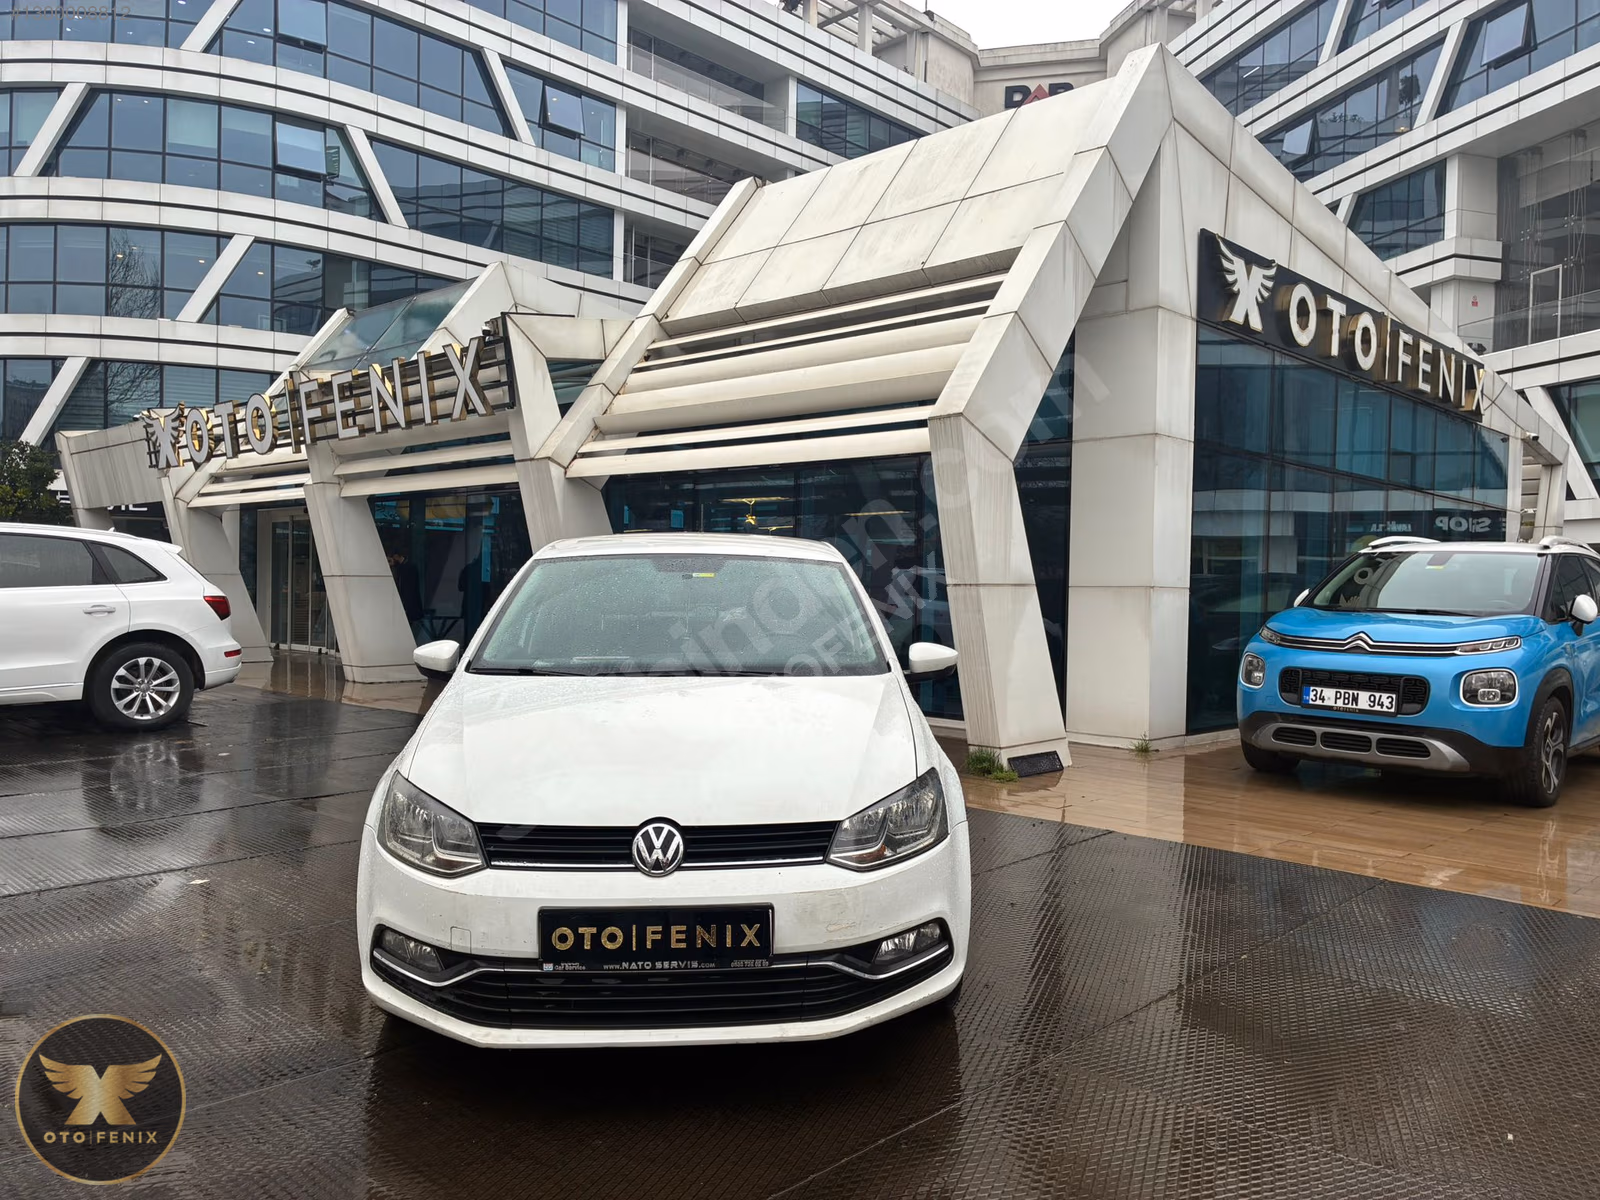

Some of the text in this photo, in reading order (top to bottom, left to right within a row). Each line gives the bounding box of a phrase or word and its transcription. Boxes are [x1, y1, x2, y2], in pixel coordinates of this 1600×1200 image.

[1311, 688, 1326, 703] 34
[1334, 690, 1360, 707] PBN
[1368, 693, 1394, 710] 943
